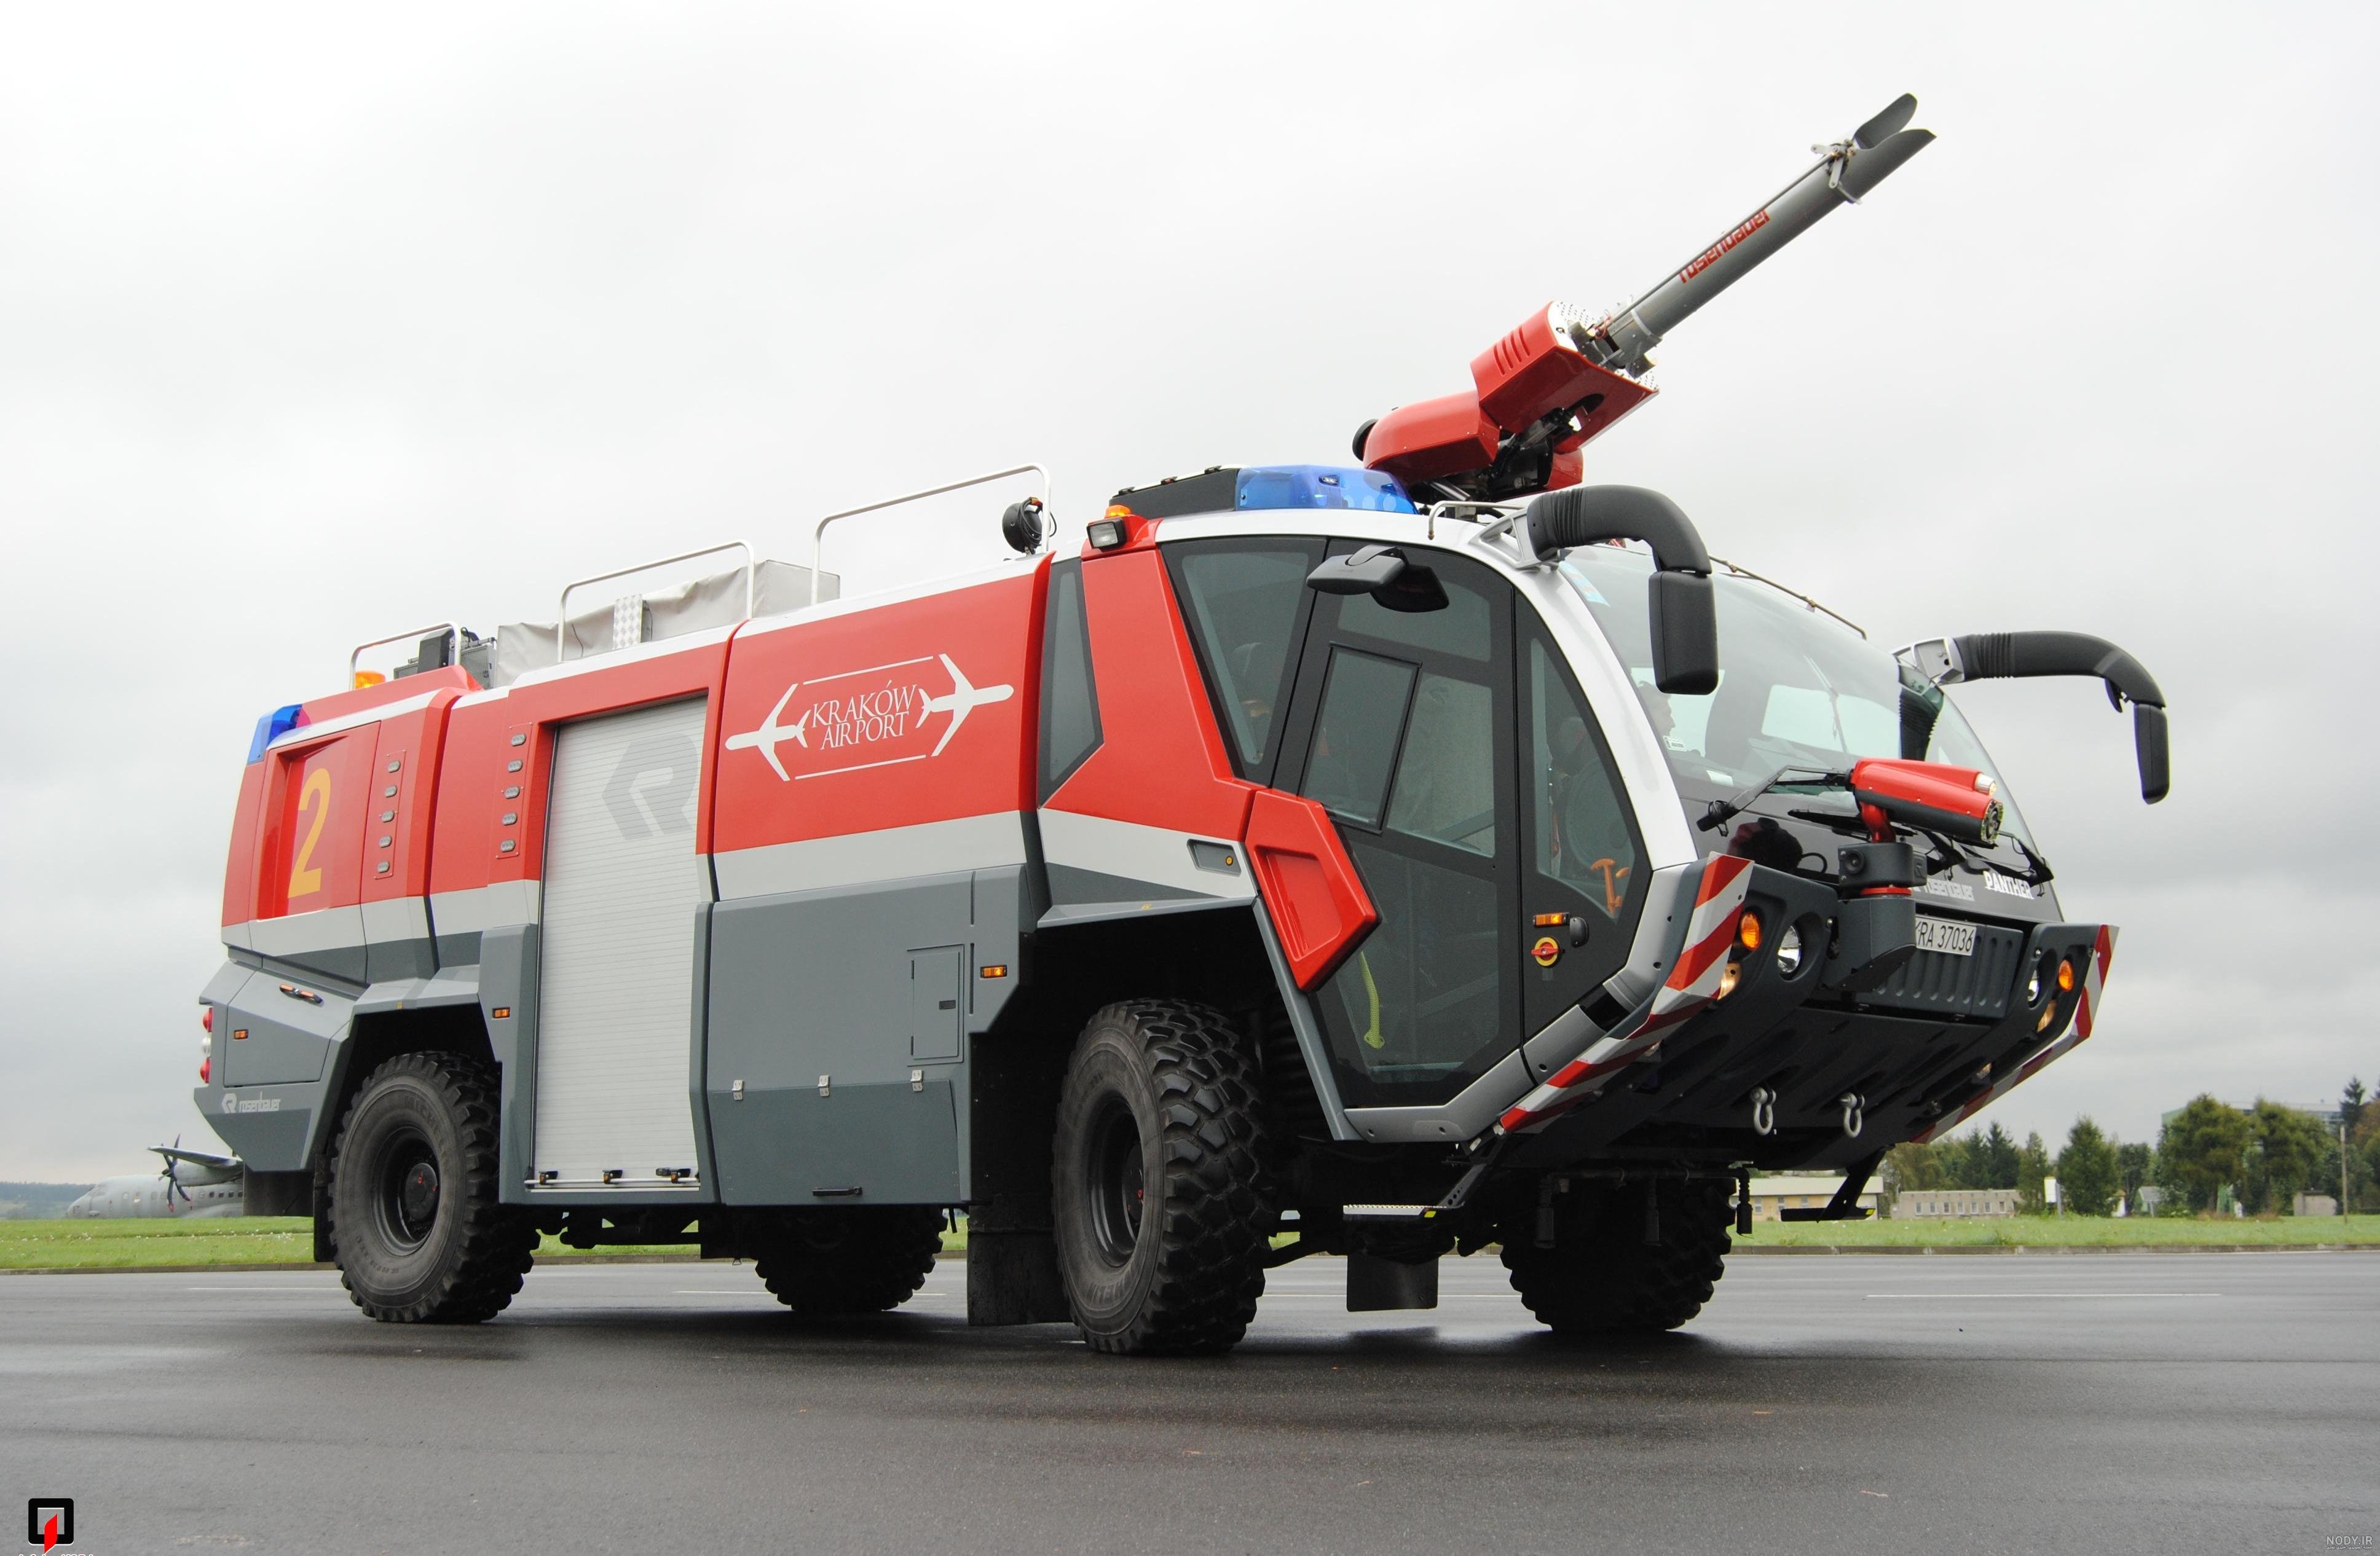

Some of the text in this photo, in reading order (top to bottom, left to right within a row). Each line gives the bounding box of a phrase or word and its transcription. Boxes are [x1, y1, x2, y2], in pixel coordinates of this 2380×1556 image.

[811, 680, 918, 728] KRAKÓW
[819, 710, 910, 750] AIRPORT
[287, 768, 331, 899] 2
[1983, 870, 2035, 900] PANTHER
[1937, 925, 1975, 952] 37036
